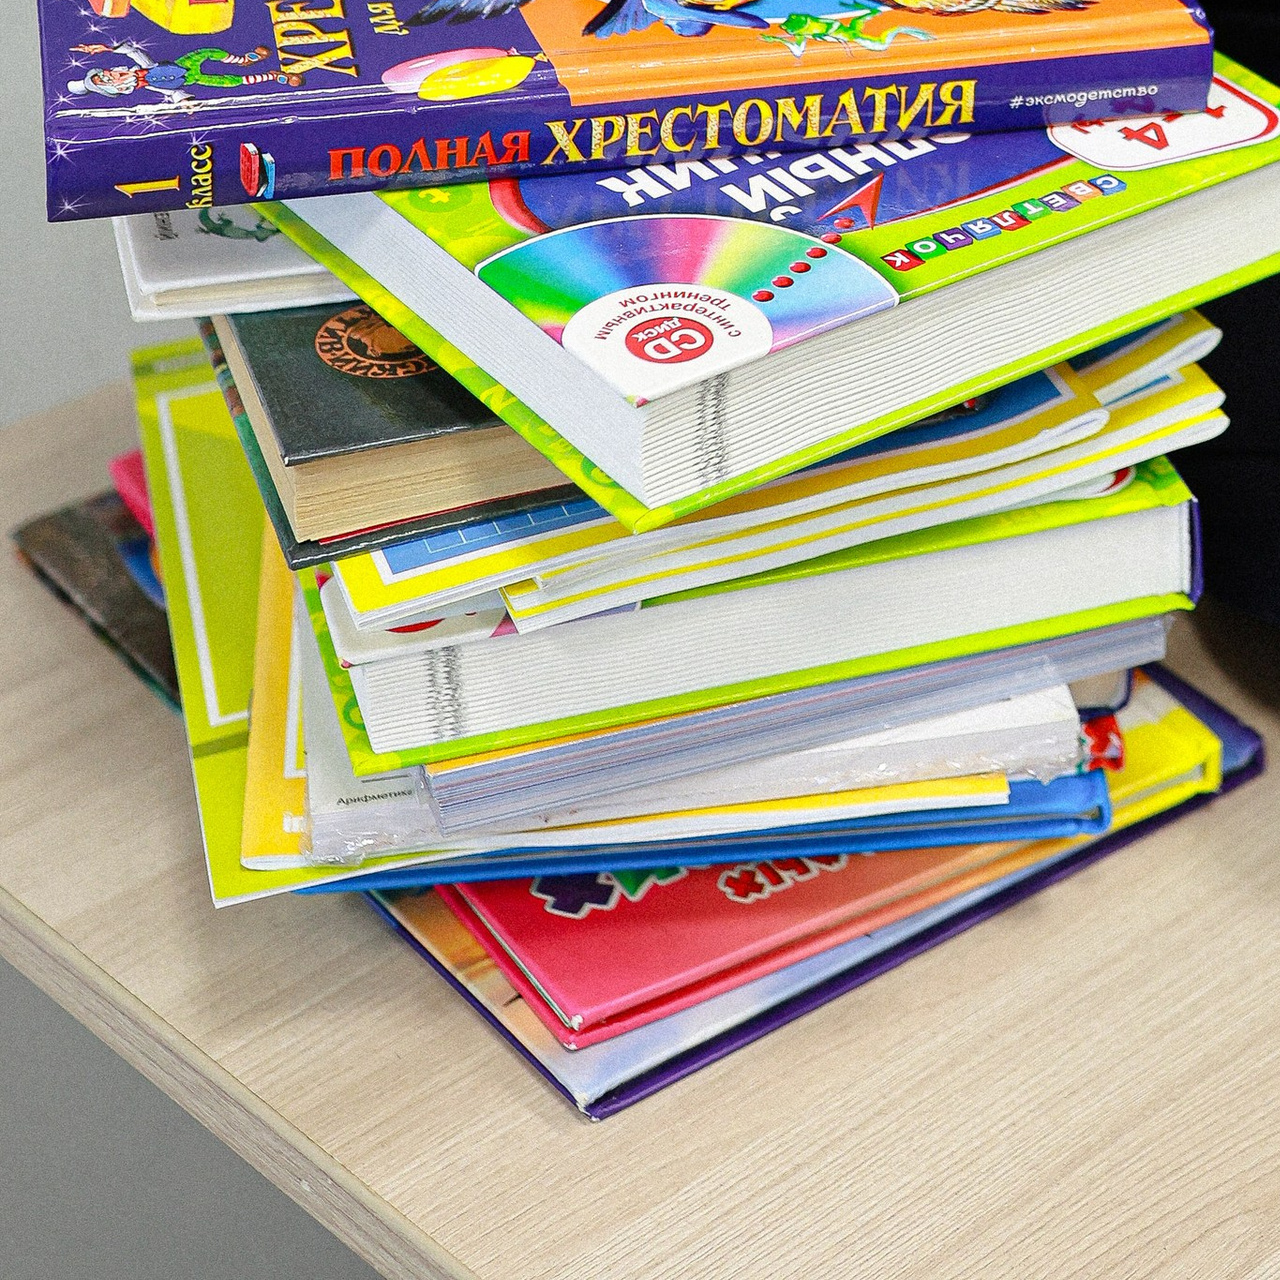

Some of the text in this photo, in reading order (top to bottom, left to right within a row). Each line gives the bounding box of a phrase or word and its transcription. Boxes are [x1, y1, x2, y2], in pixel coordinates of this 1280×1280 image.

[367, 2, 410, 36] для
[327, 130, 531, 181] ПОЛНАЯ
[542, 79, 978, 167] ХРЕСТОМАТИЯ
[1009, 84, 1159, 109] #эксмодетство
[114, 175, 180, 198] 1
[185, 143, 214, 209] класс
[884, 176, 1120, 267] СВЕТЛЯЧОК
[619, 291, 732, 312] тренингом
[594, 302, 735, 342] интерактивным
[643, 328, 706, 361] CD
